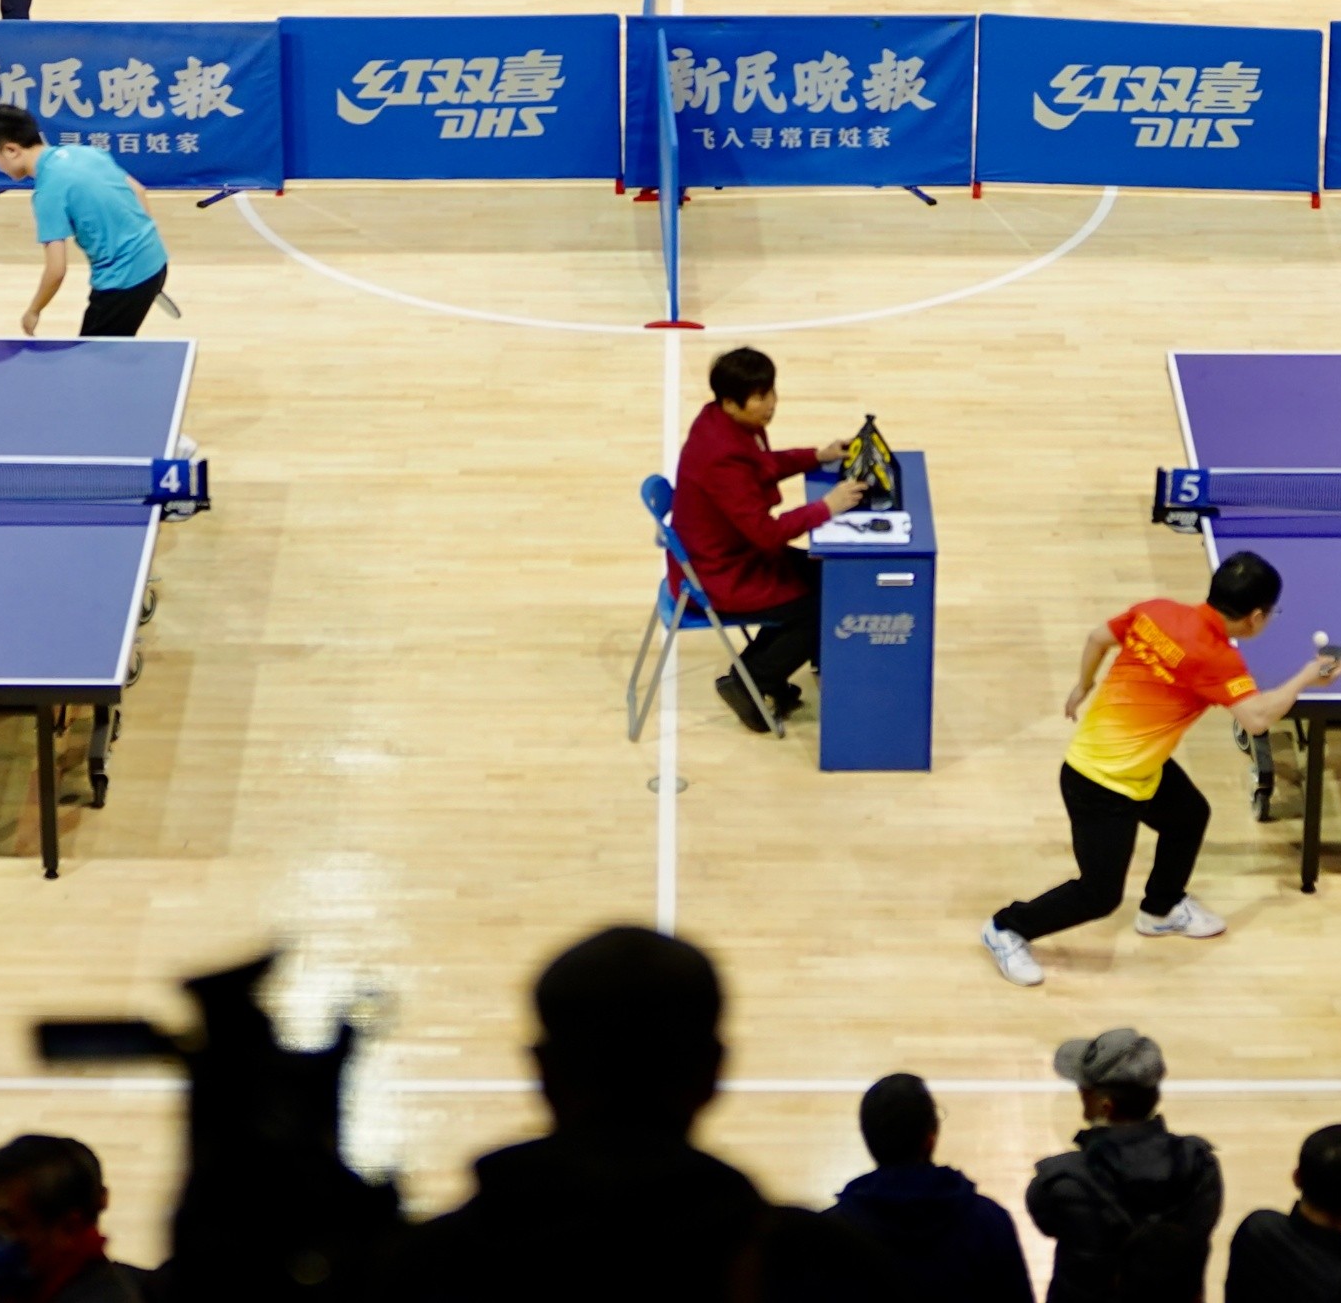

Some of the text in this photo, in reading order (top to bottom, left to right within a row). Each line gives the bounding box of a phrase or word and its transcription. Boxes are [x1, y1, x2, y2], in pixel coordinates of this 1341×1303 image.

[338, 49, 566, 125] 红双喜
[1033, 60, 1263, 130] 红双喜
[434, 105, 558, 140] DHS
[692, 126, 892, 149] 飞入寻常百姓家
[1129, 116, 1255, 149] DHS
[43, 131, 201, 154] 寻常百姓家
[158, 464, 182, 493] 4
[1179, 475, 1200, 502] 5
